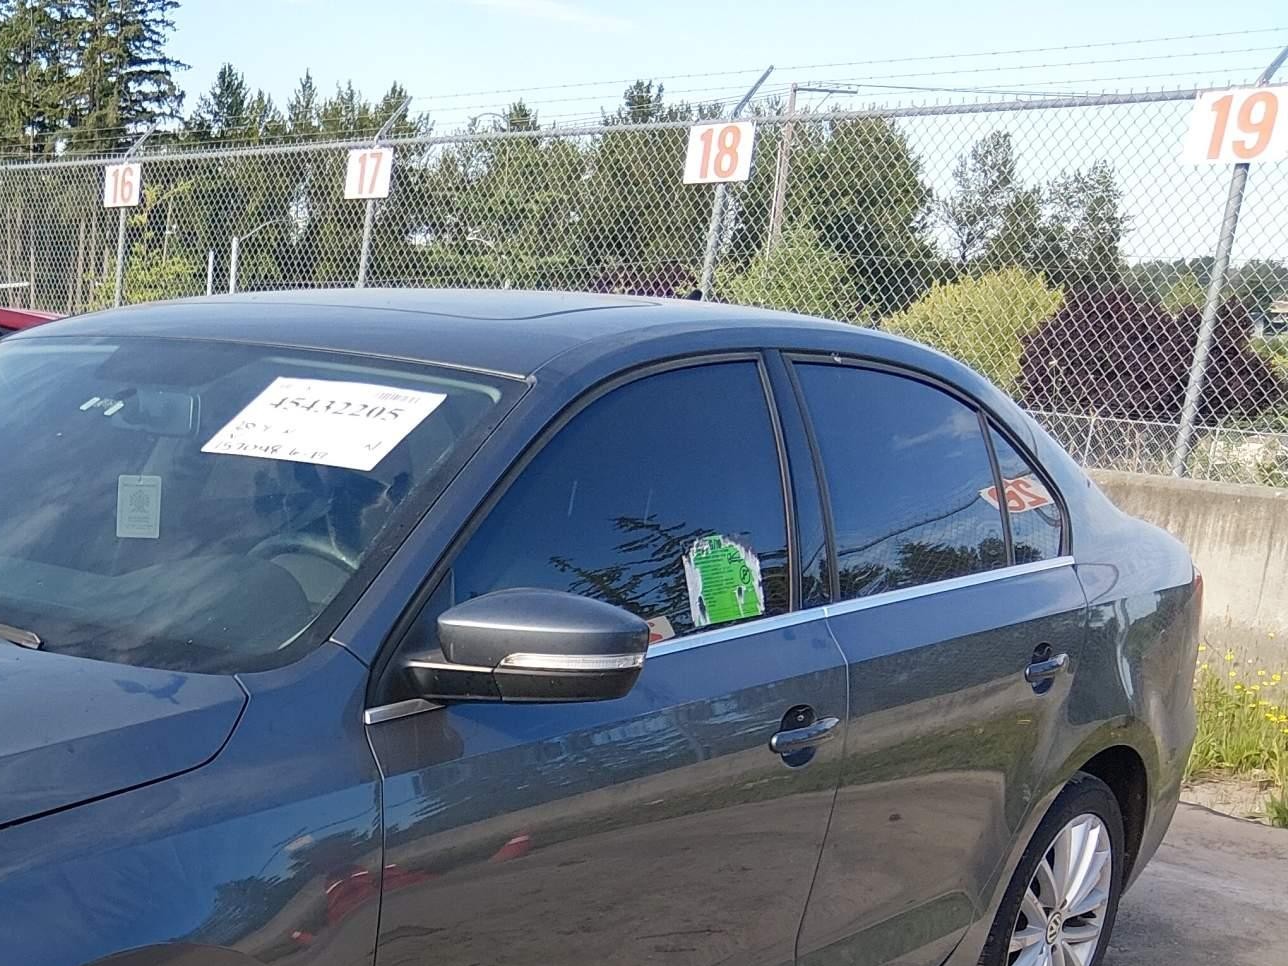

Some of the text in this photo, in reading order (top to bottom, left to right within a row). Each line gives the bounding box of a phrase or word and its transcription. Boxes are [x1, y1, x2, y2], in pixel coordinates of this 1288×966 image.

[1207, 91, 1279, 160] 19
[358, 152, 383, 194] 17
[699, 126, 742, 178] 18
[112, 167, 134, 203] 16
[269, 397, 406, 421] 45432205
